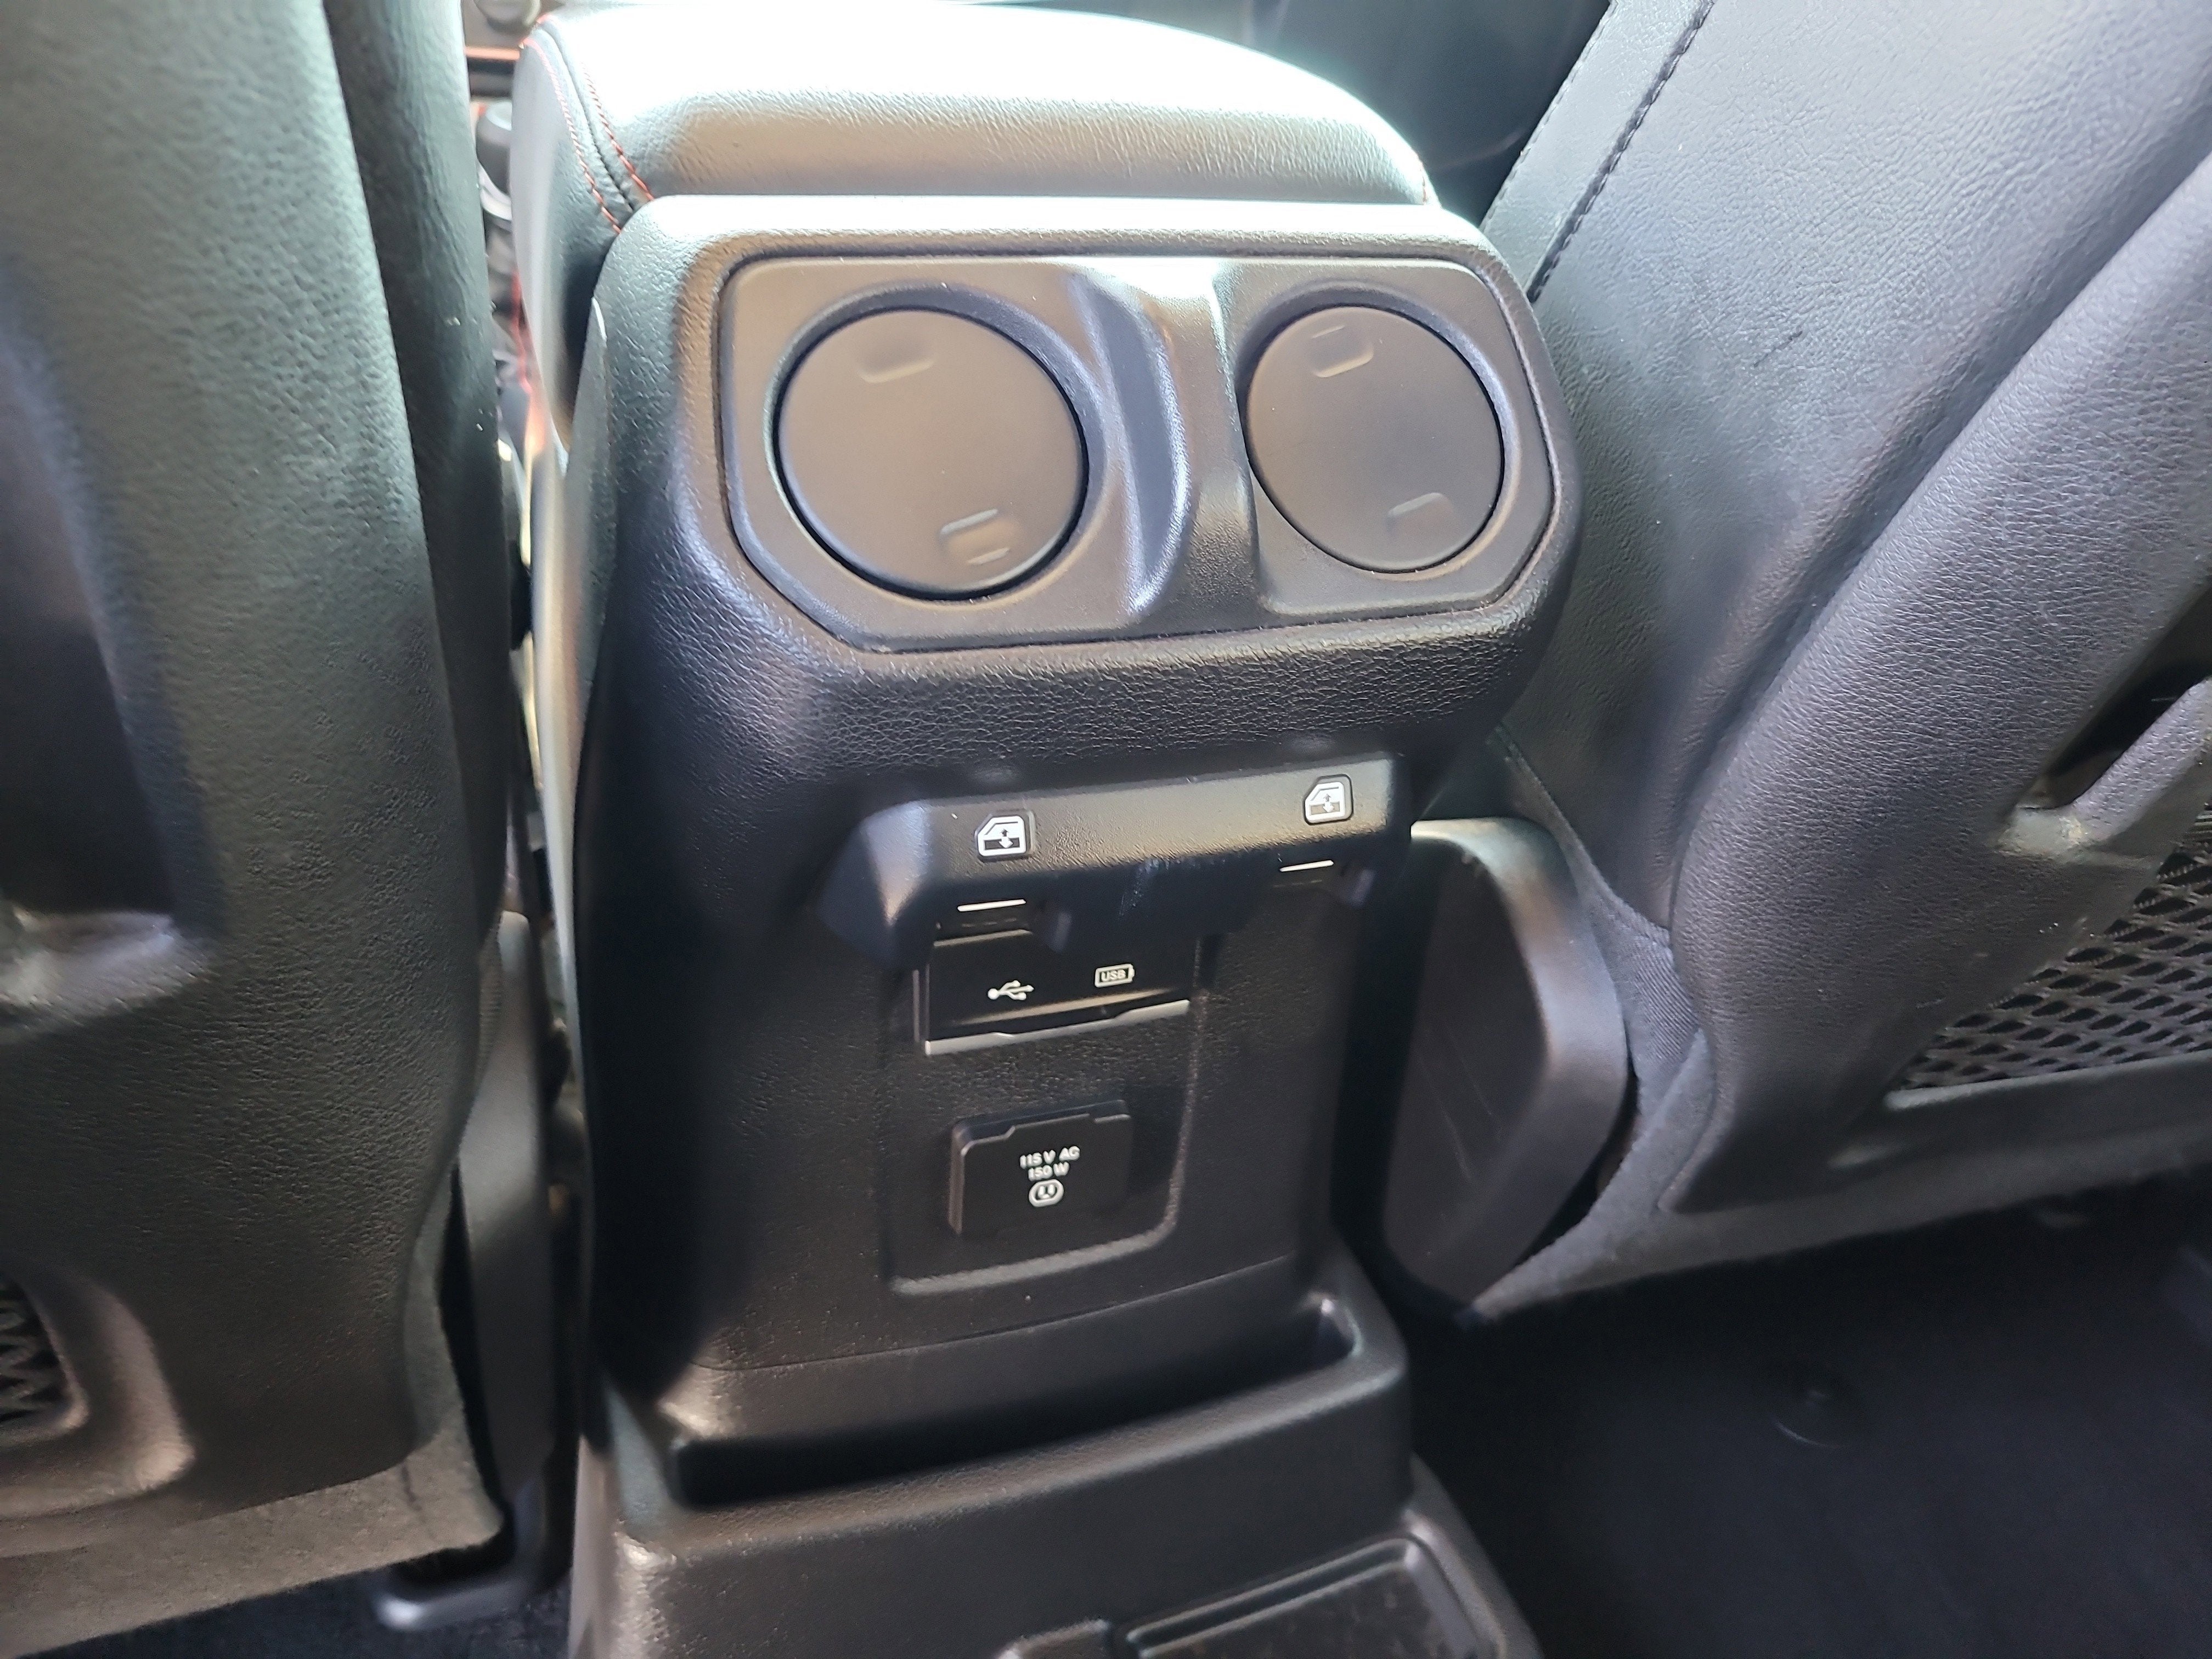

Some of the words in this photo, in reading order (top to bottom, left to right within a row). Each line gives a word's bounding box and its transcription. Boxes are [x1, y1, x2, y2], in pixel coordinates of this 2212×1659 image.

[1101, 969, 1126, 981] USB
[1019, 1152, 1042, 1169] 115
[1043, 1150, 1056, 1164] V
[1028, 1165, 1053, 1181] 150
[1053, 1162, 1070, 1176] W
